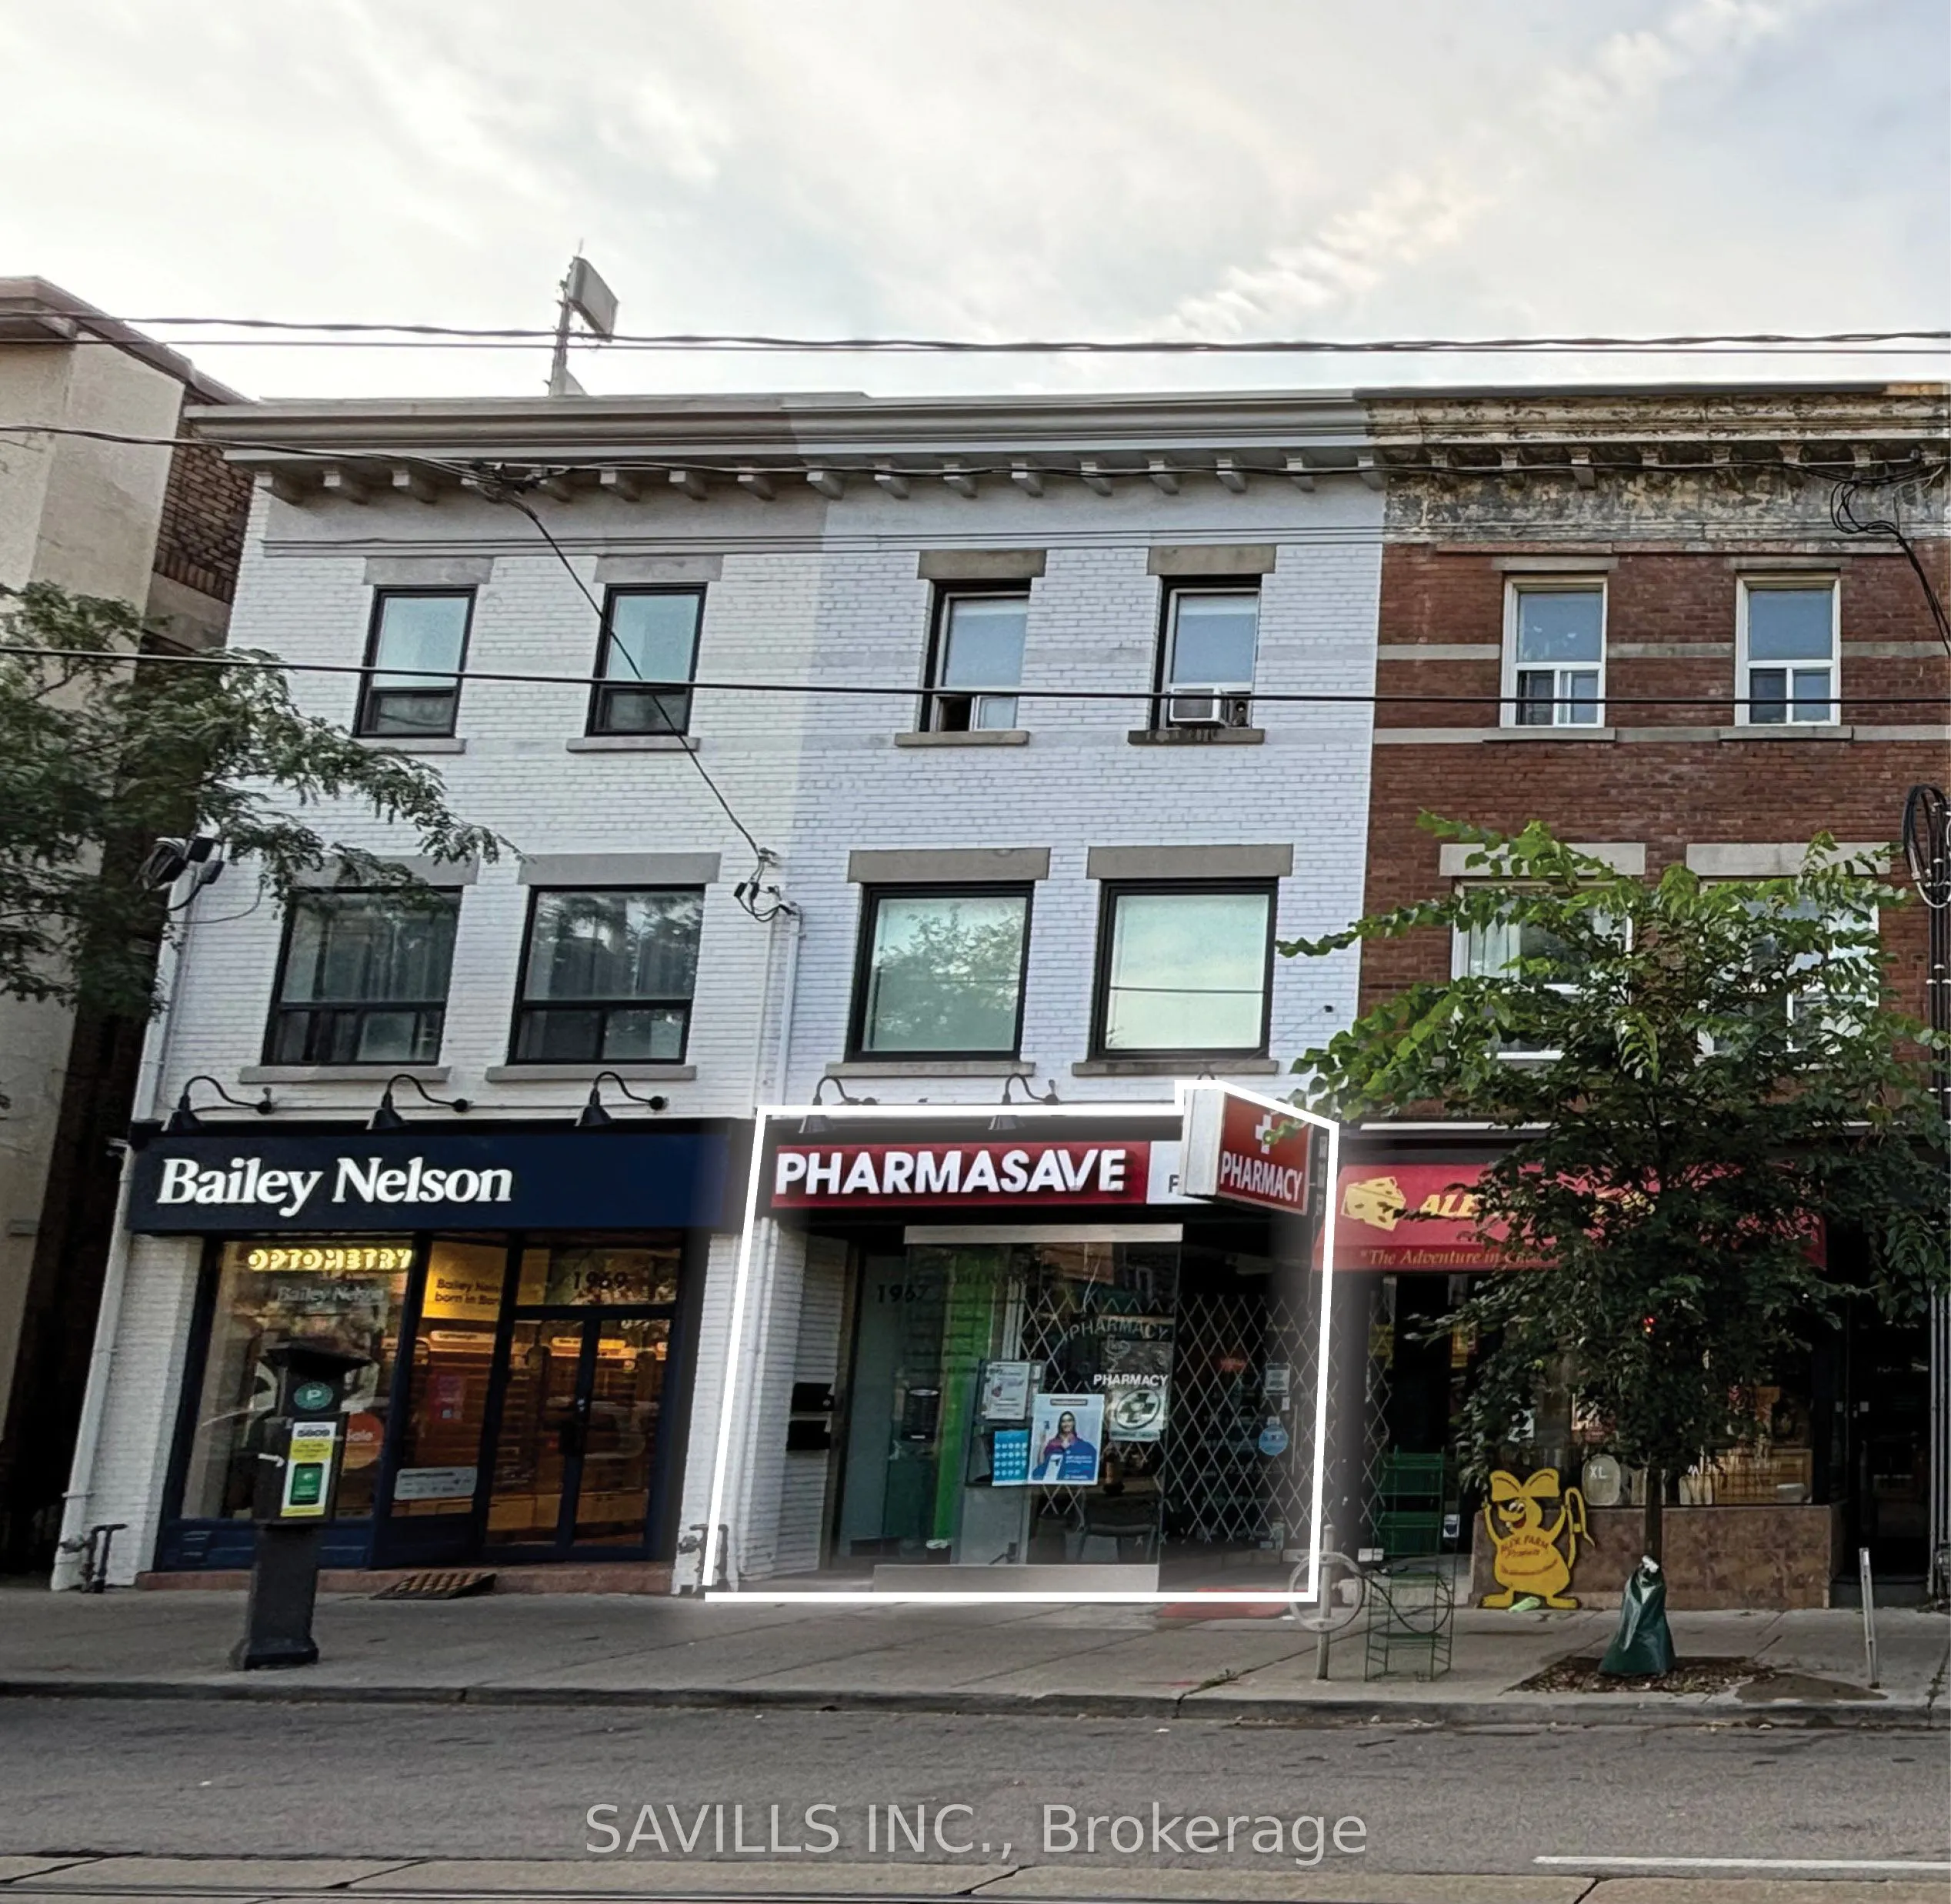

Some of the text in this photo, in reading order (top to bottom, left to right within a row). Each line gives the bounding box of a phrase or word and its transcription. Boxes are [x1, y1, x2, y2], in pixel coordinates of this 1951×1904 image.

[775, 1149, 1126, 1195] PHARMASAVE
[1220, 1151, 1303, 1202] PHARMACY
[156, 1157, 513, 1217] Bailey Nelson
[1399, 1249, 1481, 1266] Adventure
[572, 1271, 628, 1290] 1969
[877, 1283, 930, 1303] 1967
[1069, 1317, 1170, 1341] PHARMACY
[1093, 1373, 1169, 1386] PHARMACY
